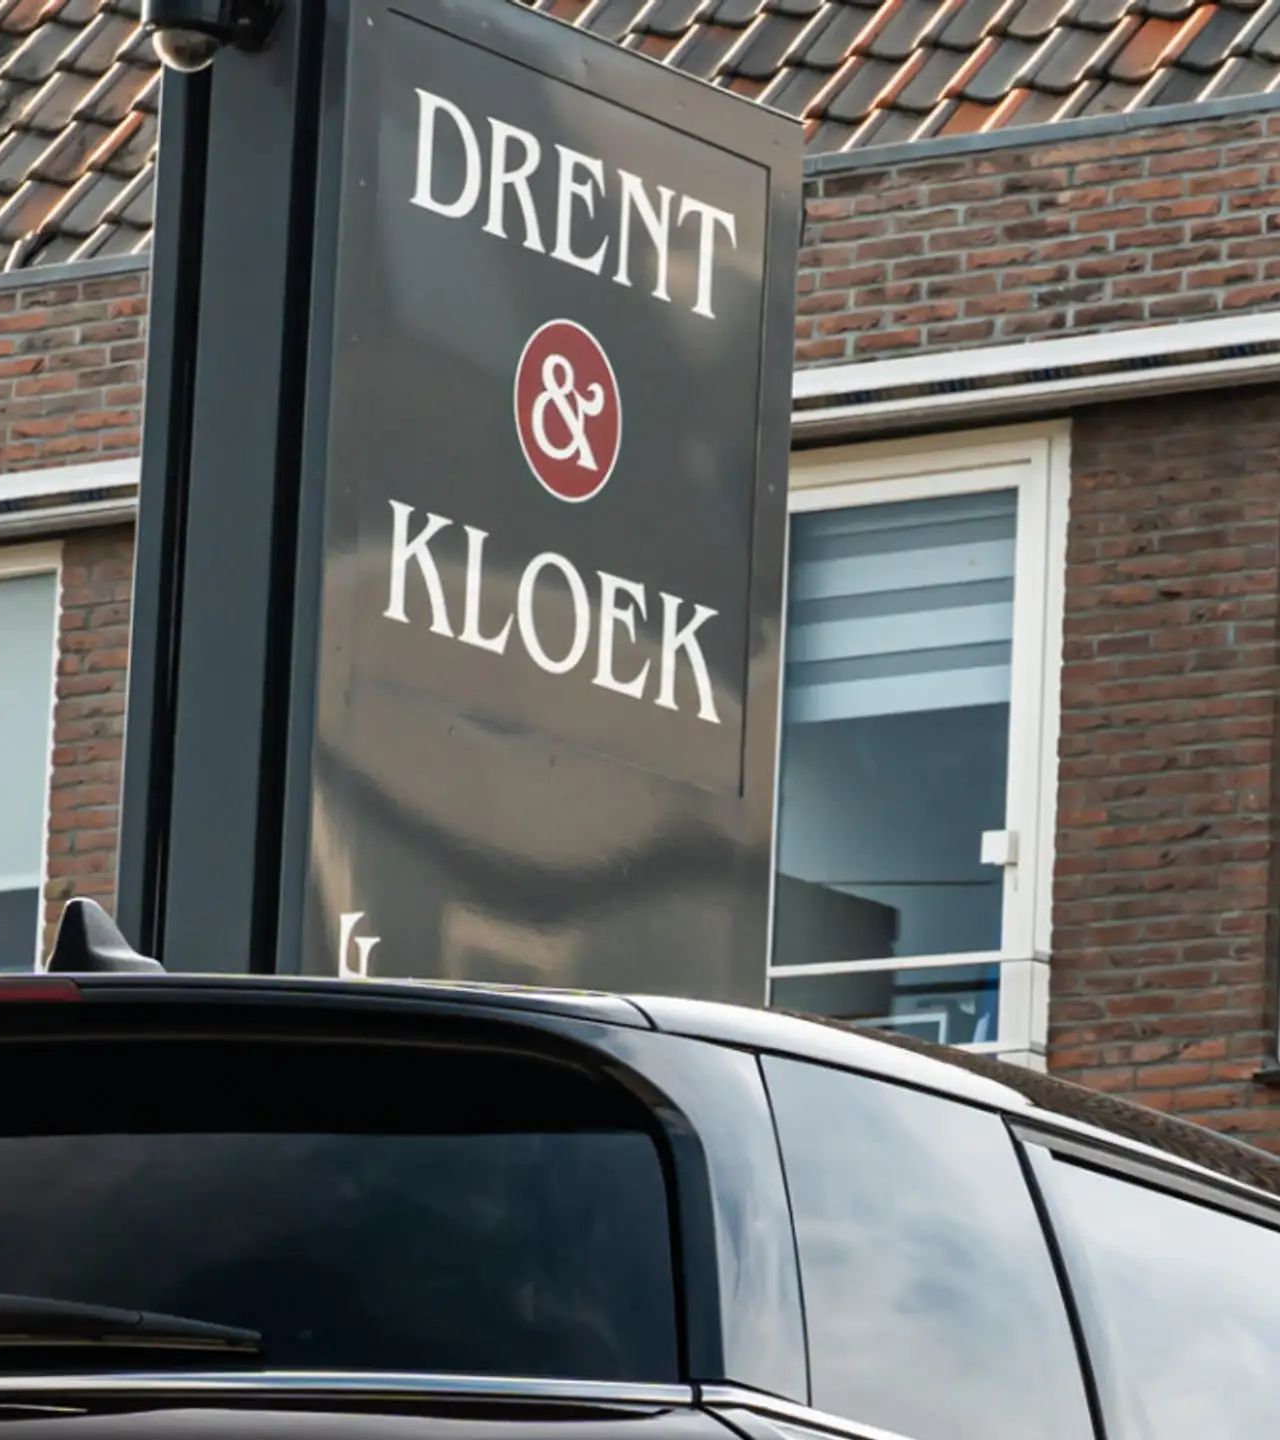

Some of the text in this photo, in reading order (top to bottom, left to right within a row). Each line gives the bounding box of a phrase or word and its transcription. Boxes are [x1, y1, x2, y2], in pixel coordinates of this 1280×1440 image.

[410, 87, 738, 320] DRENT
[531, 352, 605, 472] &
[383, 500, 721, 724] KLOEK
